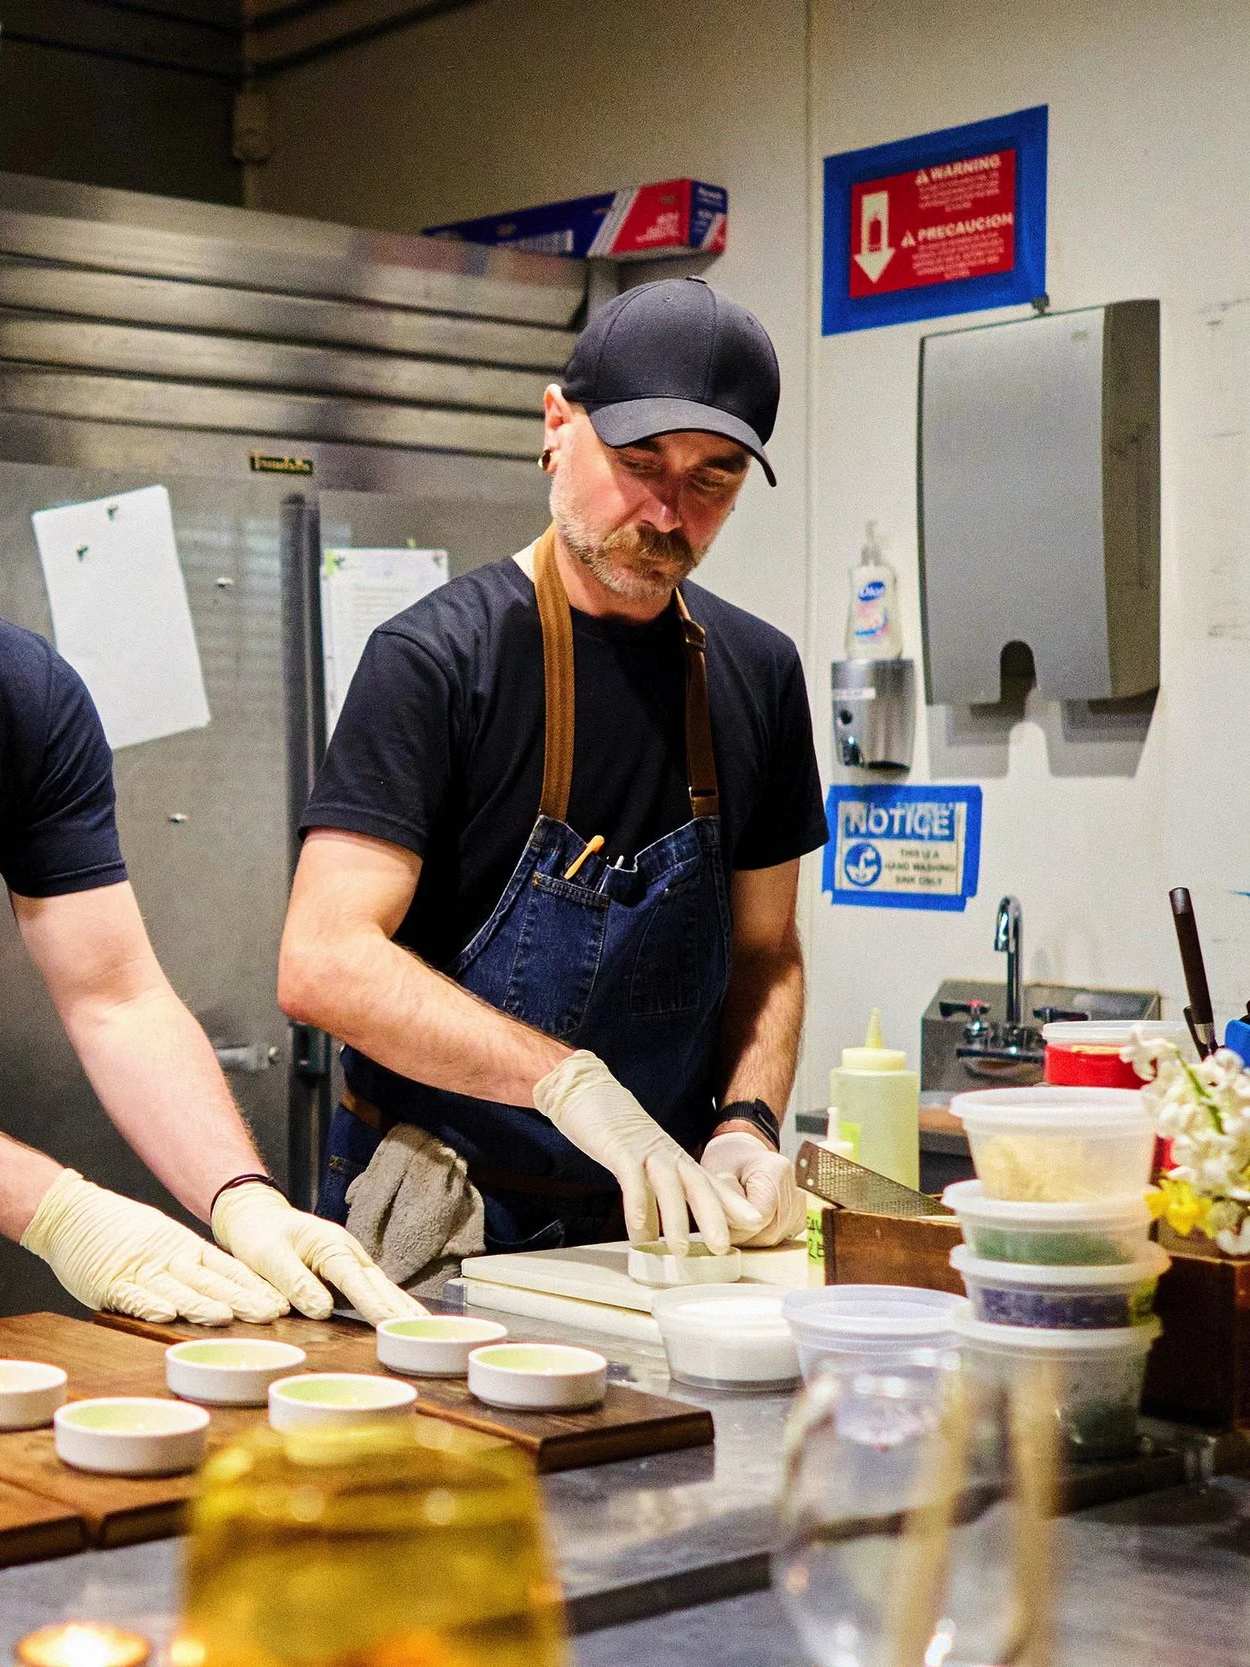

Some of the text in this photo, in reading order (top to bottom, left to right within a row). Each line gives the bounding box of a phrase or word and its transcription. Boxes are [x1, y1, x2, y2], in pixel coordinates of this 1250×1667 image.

[930, 154, 1002, 182] WARNING
[917, 212, 1014, 242] PRECAUCION
[848, 806, 951, 837] NOTICE
